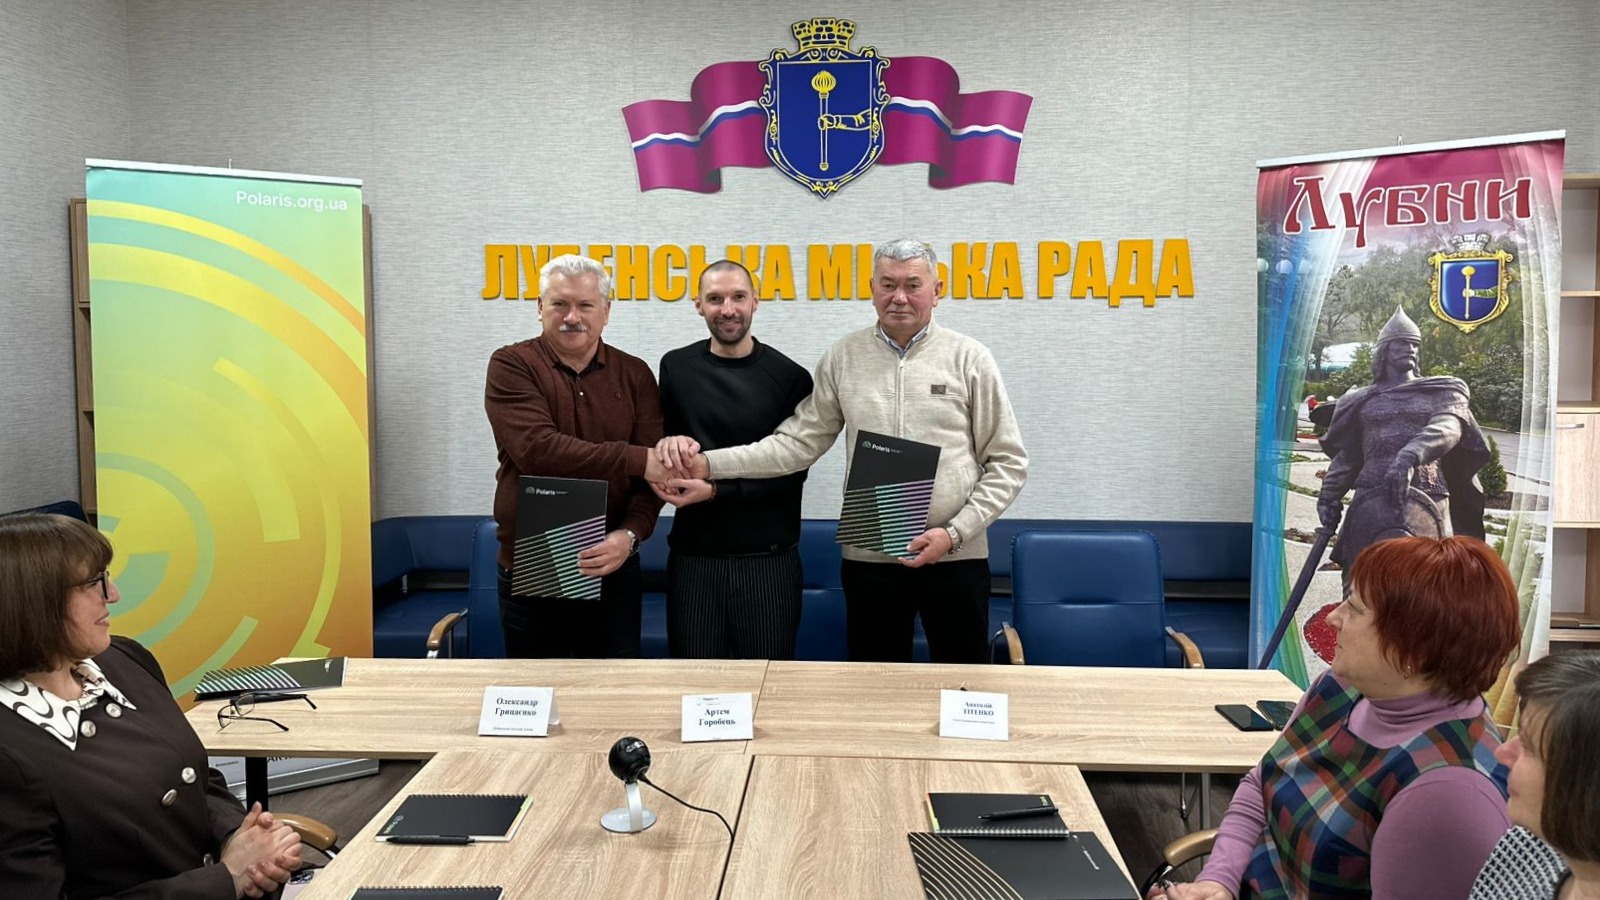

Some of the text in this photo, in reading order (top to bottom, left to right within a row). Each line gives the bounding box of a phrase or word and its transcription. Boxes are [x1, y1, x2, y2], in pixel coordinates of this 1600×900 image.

[236, 190, 348, 212] Polaris.org.ua
[482, 238, 1195, 307] ЛУНСЬКА МІКА РАДА
[496, 697, 539, 707] Олександр
[704, 709, 730, 717] Артем
[699, 718, 736, 727] Горобець
